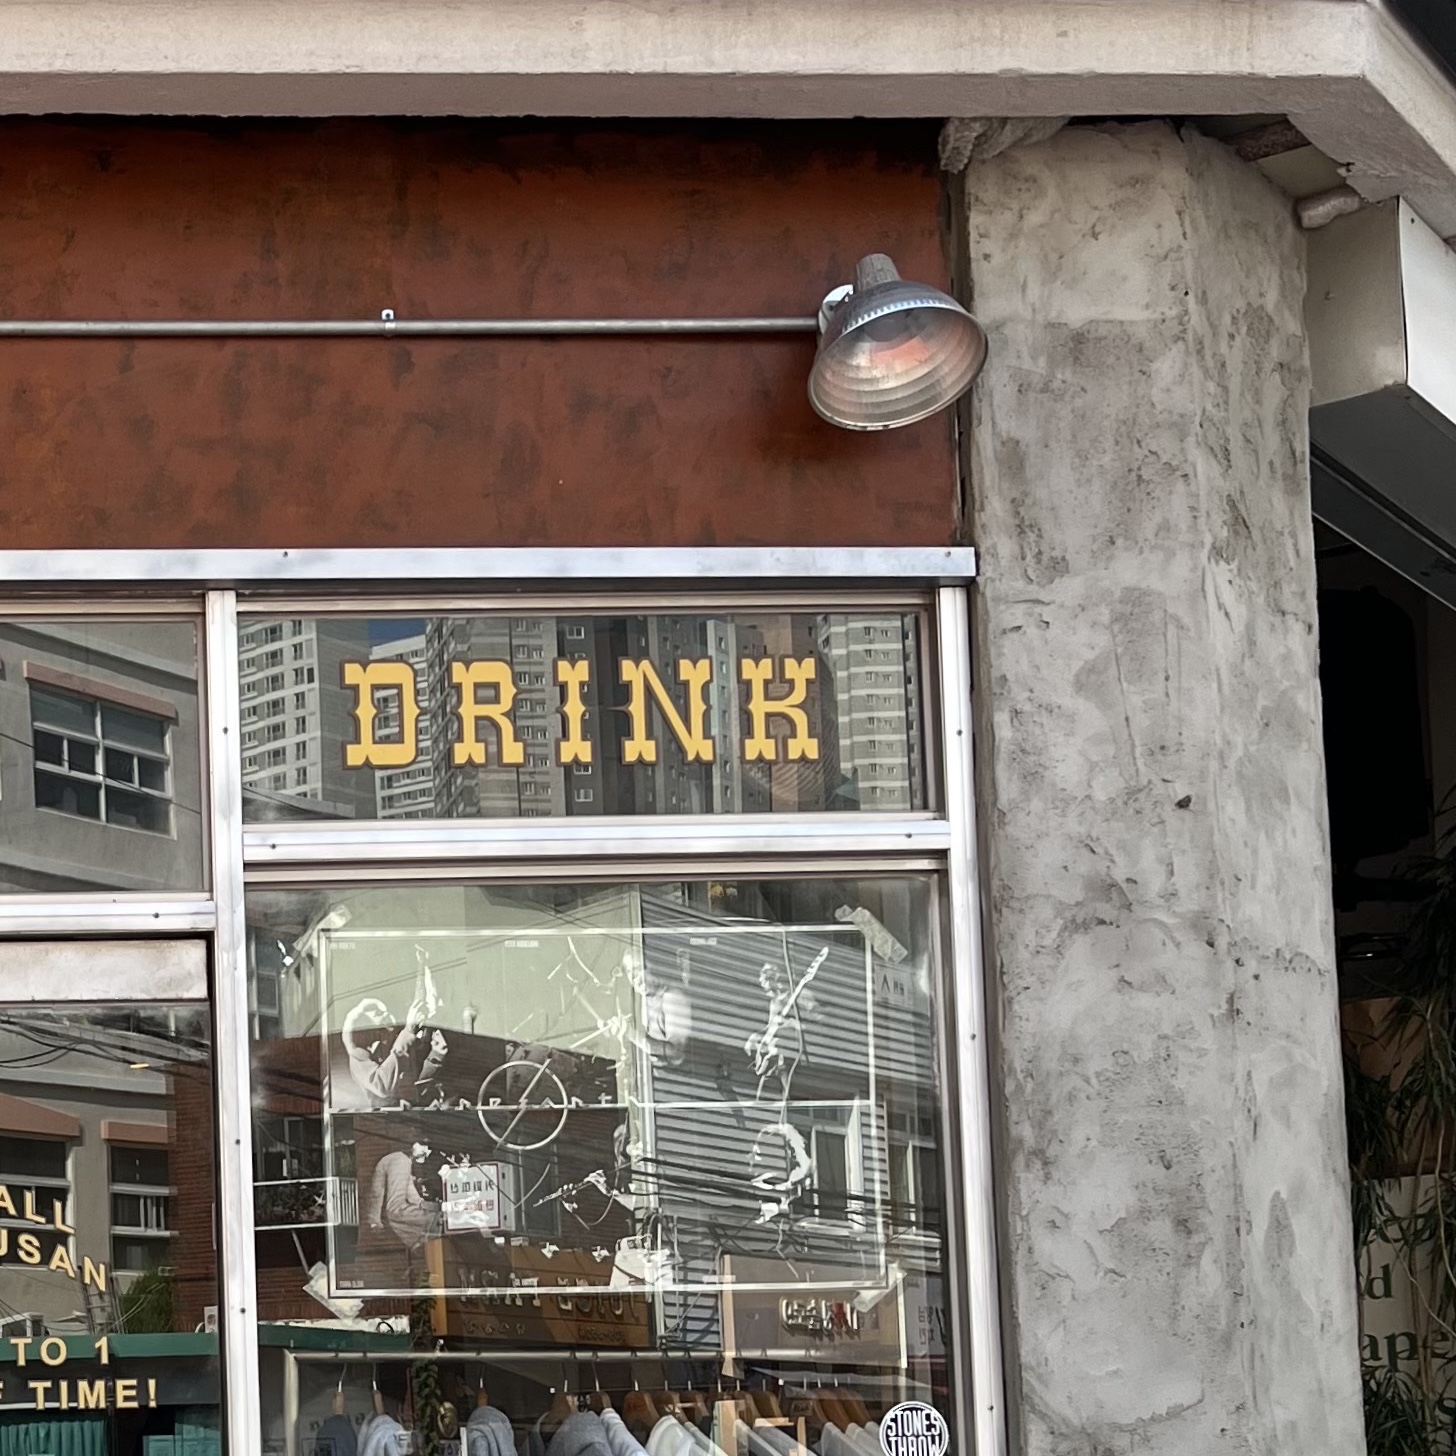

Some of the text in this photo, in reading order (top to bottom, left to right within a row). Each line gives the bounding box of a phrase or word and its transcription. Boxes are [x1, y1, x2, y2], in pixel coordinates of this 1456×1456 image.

[341, 657, 824, 769] DRINK
[9, 1336, 68, 1367] TO
[95, 1336, 110, 1366] 1
[28, 1378, 158, 1411] TIME!
[887, 1410, 941, 1437] STONES
